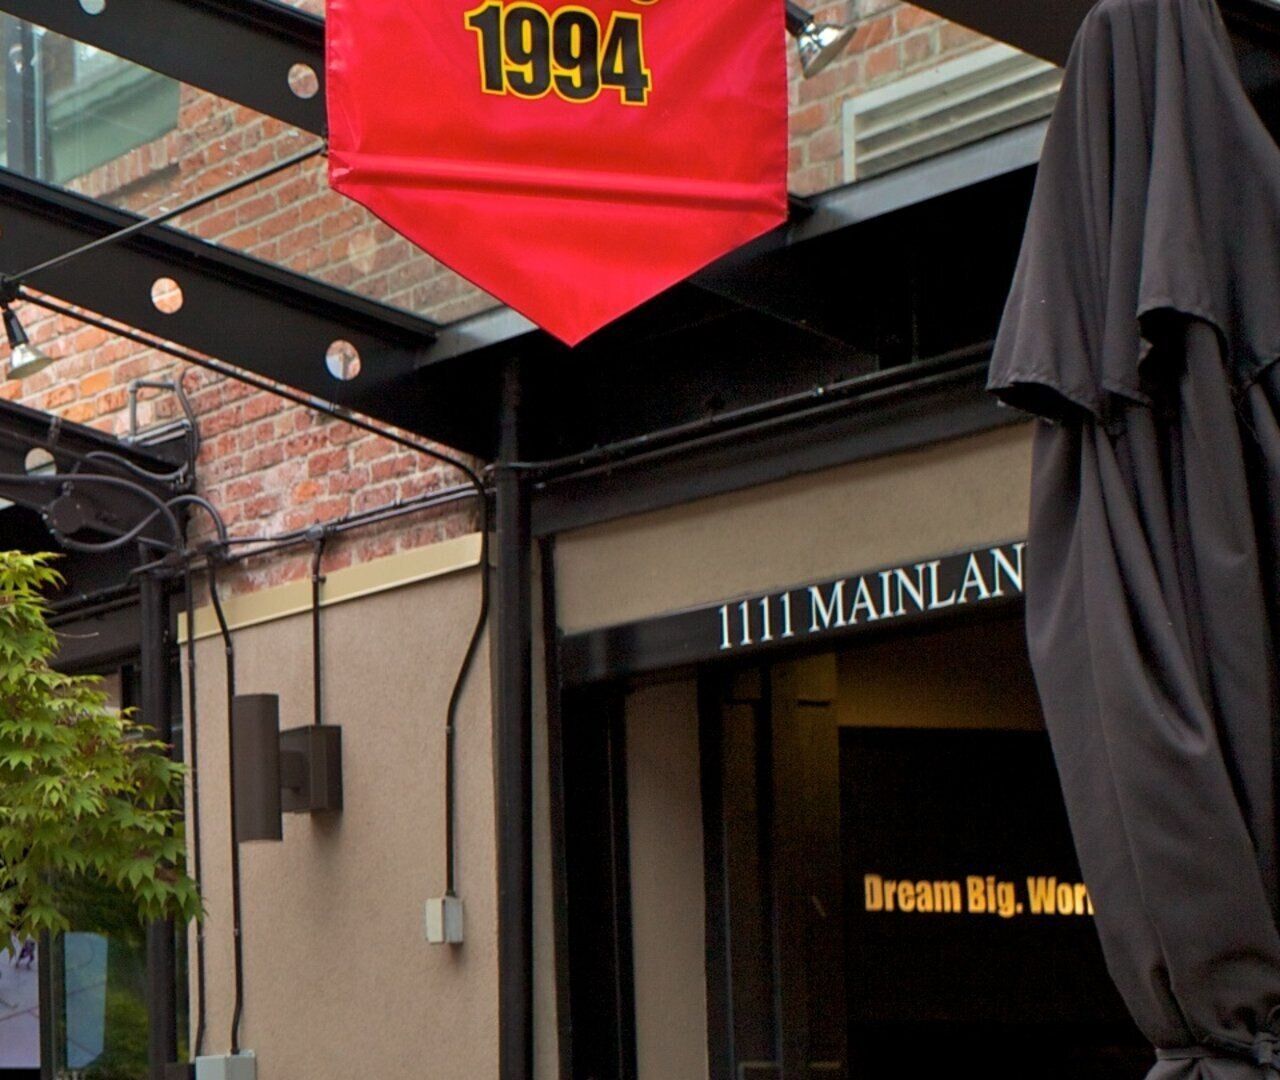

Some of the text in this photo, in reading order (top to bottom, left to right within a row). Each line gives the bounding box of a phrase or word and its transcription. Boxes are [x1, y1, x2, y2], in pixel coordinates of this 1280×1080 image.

[464, 0, 651, 105] 1994
[719, 543, 1027, 651] 1111 MAINLAN
[863, 873, 961, 912] Dream
[966, 874, 1023, 918] Big.
